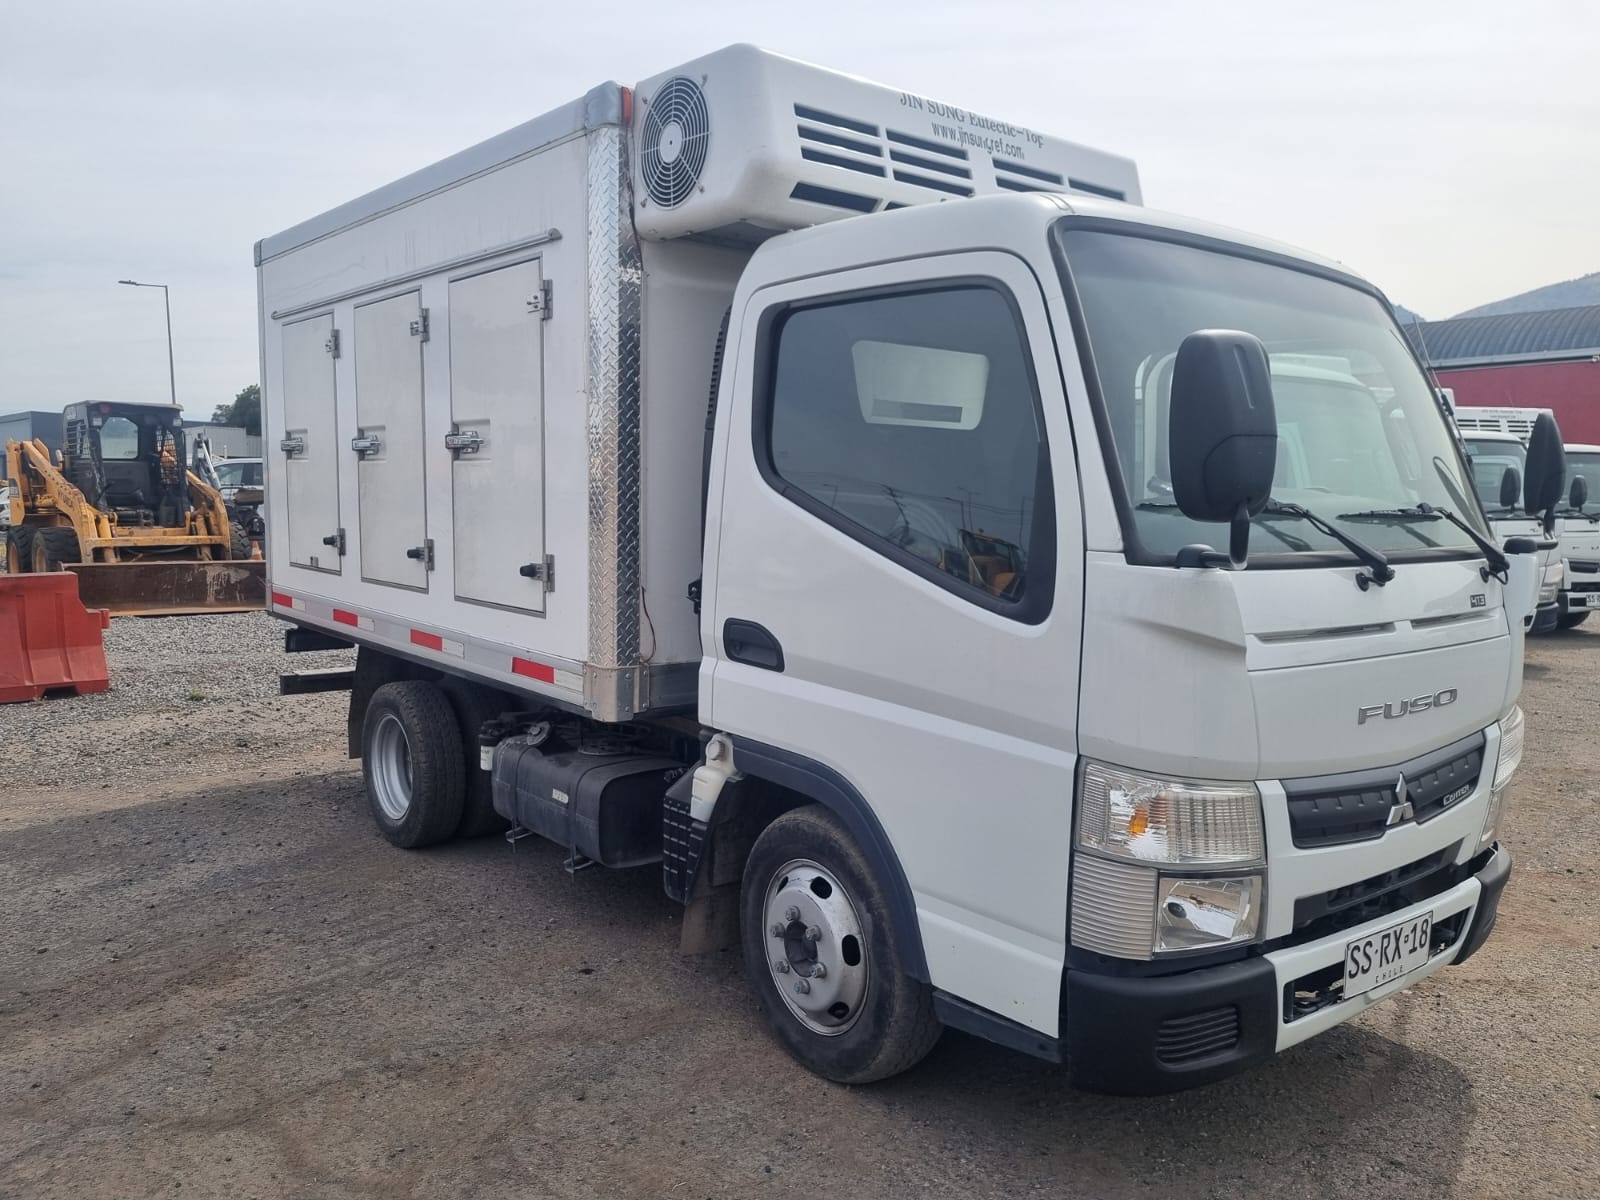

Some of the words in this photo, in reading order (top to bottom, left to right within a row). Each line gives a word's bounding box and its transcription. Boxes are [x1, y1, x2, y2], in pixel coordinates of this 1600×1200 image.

[900, 92, 923, 110] JIN
[927, 99, 966, 123] SUNG
[1357, 687, 1458, 725] FUSO
[1375, 965, 1403, 984] CHILE
